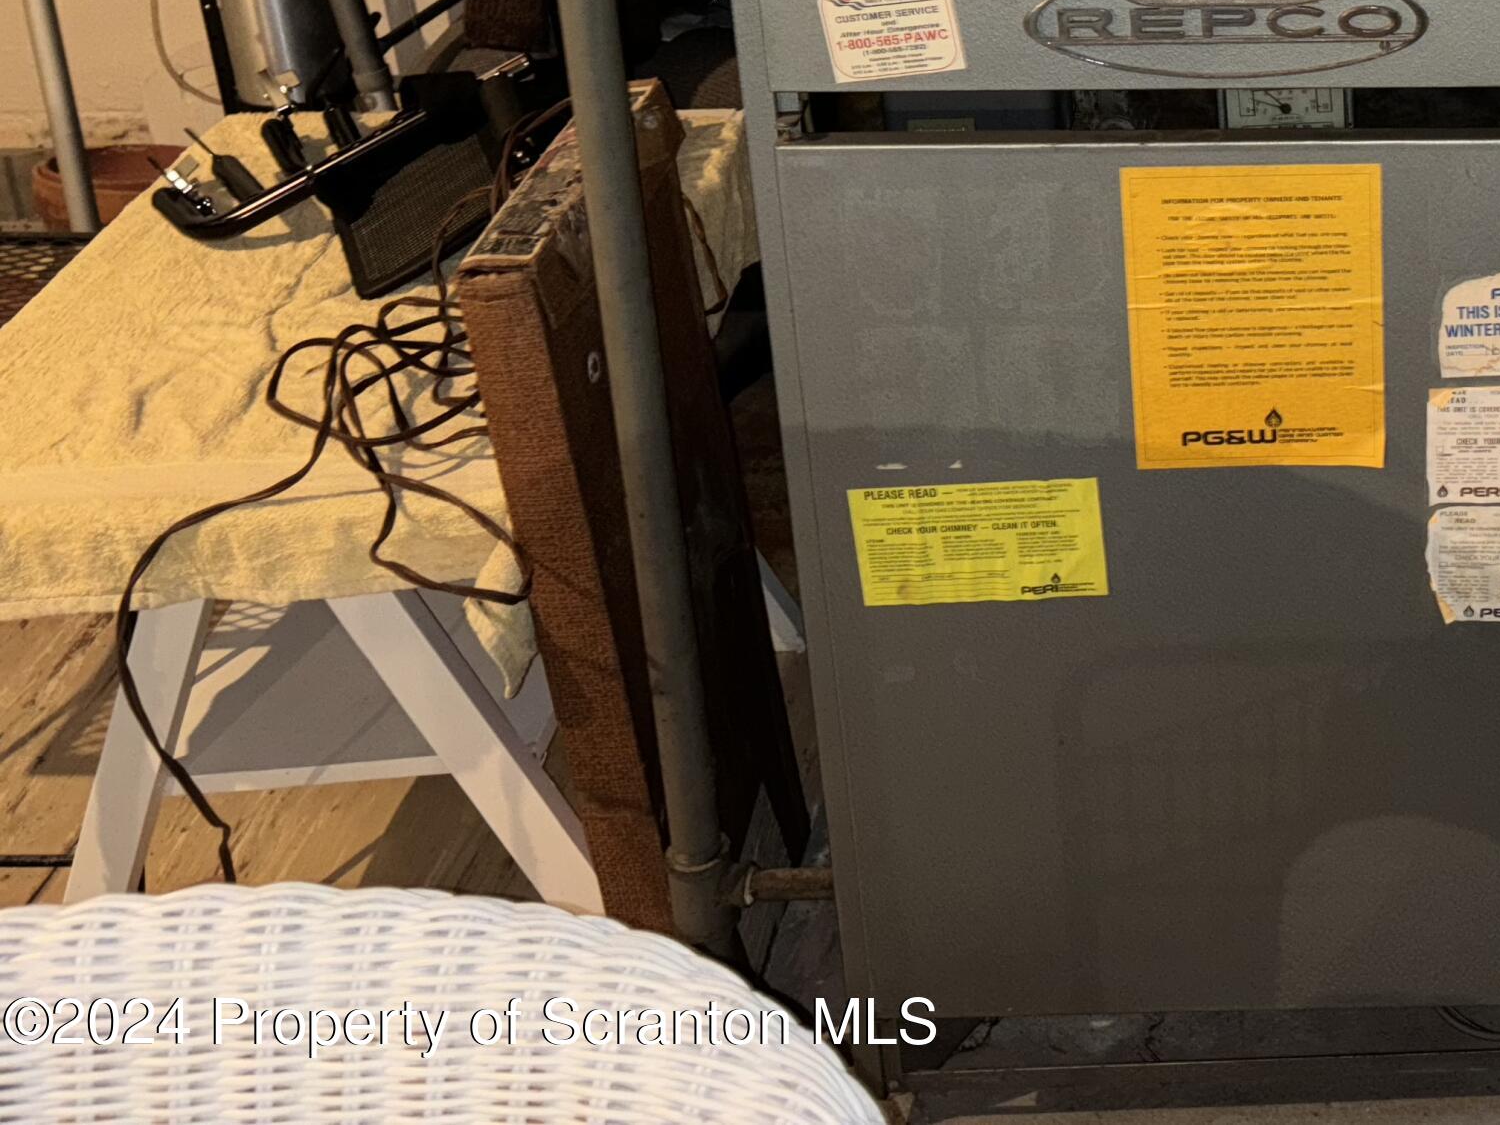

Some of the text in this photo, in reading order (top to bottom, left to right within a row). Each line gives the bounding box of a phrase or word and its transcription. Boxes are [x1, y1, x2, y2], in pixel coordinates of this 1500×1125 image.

[835, 5, 940, 24] CUSTOMER SERVICE
[1055, 6, 1402, 41] REPCO
[836, 28, 949, 51] 1-800-565-PAWC
[1456, 305, 1490, 319] THIS
[1445, 323, 1500, 338] WINTER
[1182, 428, 1277, 446] PG&W
[863, 488, 937, 501] PLEASE READ
[886, 527, 913, 535] CHECK
[915, 526, 937, 534] YOUR
[940, 524, 978, 533] CHIMNEY
[991, 522, 1018, 531] CLEAN
[1020, 521, 1028, 529] IT
